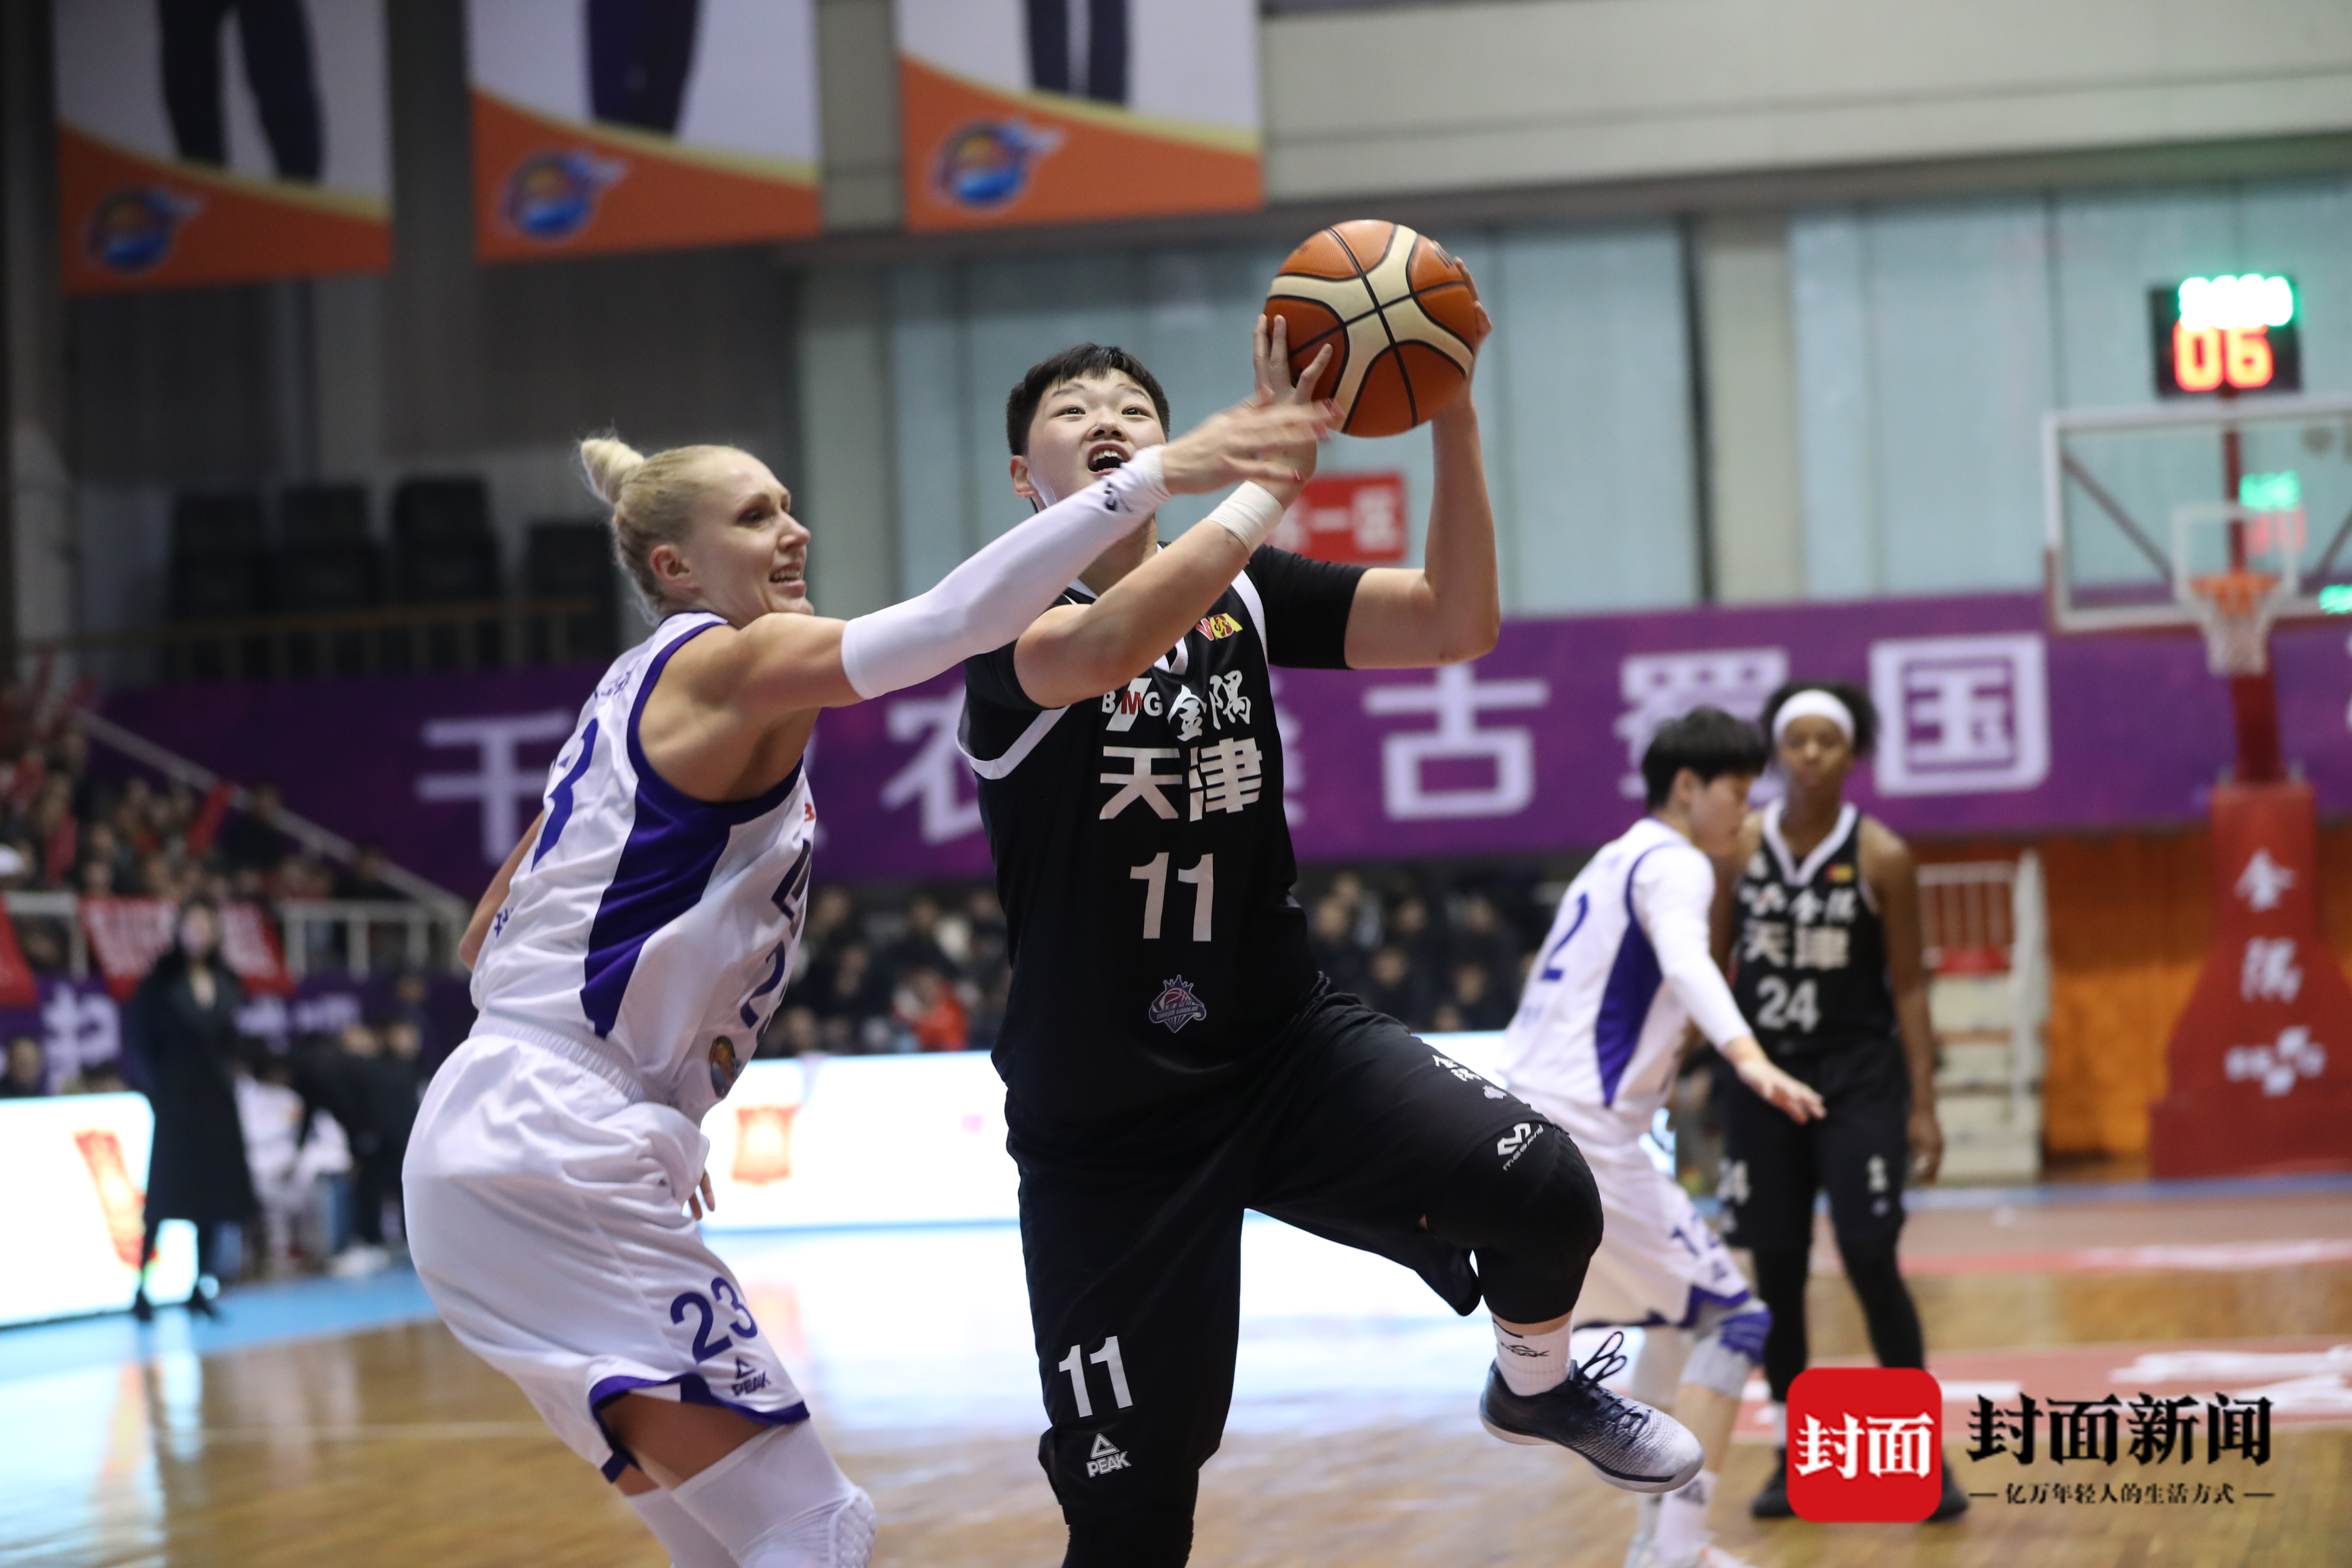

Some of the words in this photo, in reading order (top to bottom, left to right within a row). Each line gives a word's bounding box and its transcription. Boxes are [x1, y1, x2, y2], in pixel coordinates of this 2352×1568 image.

[2173, 320, 2274, 391] 06
[1101, 690, 1163, 717] BMG
[1167, 669, 1251, 742] 金隅
[1098, 737, 1263, 823] 天津
[1129, 851, 1214, 942] 11
[1756, 975, 1820, 1033] 24
[669, 1276, 758, 1366] 23
[1058, 1335, 1133, 1418] 11
[1086, 1451, 1132, 1478] PEAK
